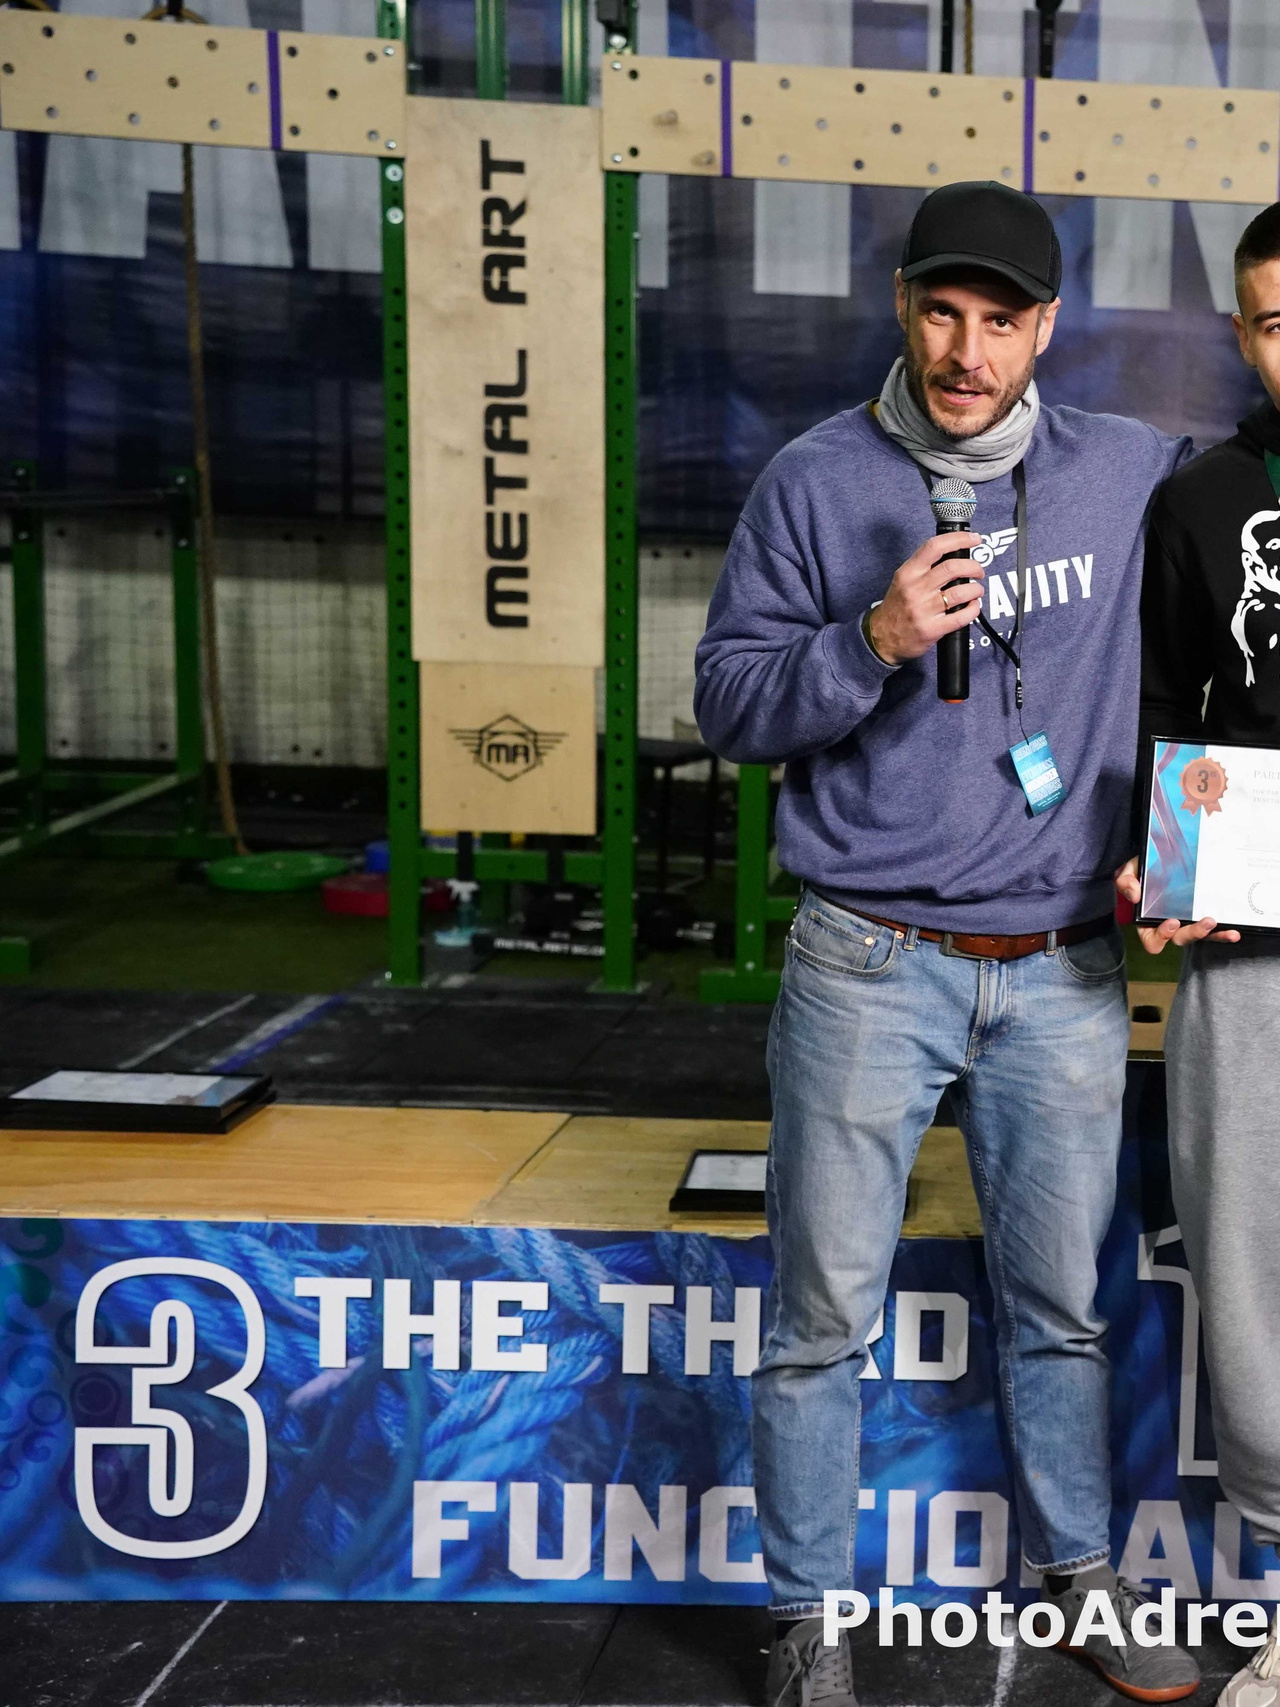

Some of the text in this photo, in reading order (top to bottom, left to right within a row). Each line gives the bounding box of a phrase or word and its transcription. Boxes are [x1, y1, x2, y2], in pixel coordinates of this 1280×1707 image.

[480, 139, 529, 629] METAL ART
[970, 554, 1094, 624] AVITY
[75, 1257, 267, 1559] 3
[294, 1277, 970, 1382] THE THD
